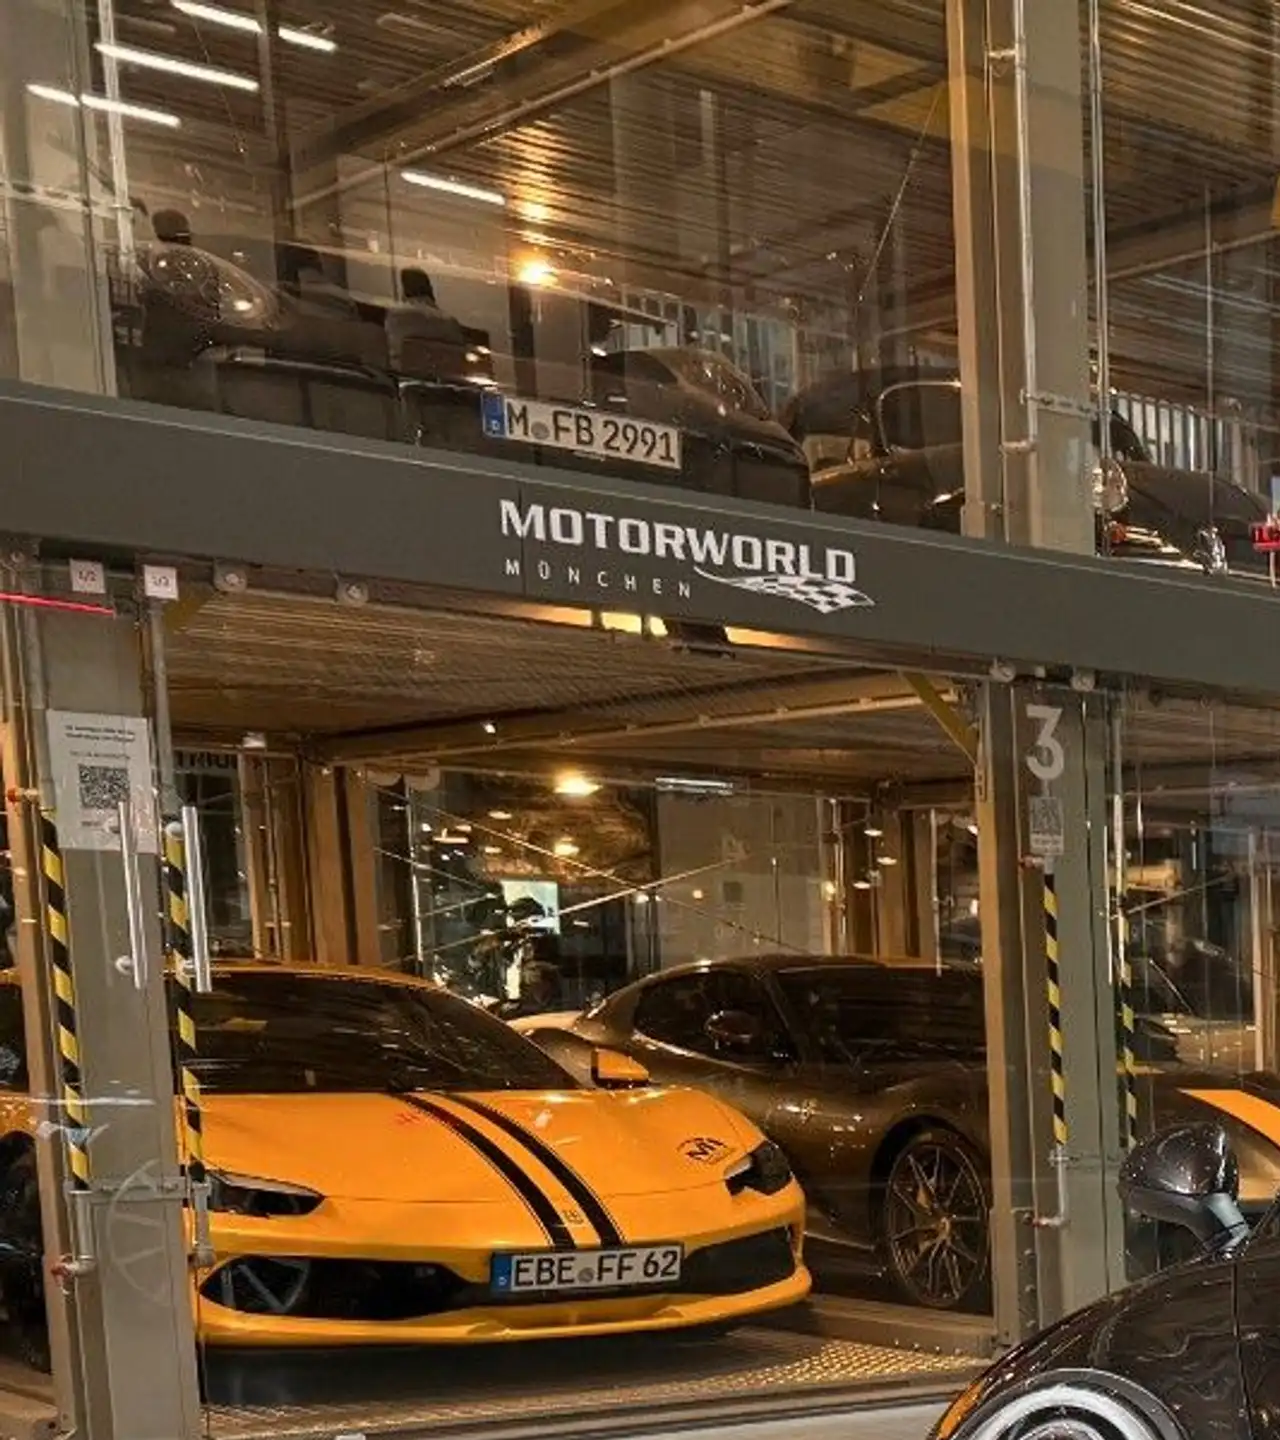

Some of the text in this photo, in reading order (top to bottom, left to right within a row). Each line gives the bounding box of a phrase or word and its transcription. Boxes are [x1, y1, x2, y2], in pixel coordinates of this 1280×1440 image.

[508, 402, 529, 436] M
[552, 410, 594, 446] FB
[602, 420, 676, 463] 2991
[500, 499, 856, 584] MOTORWORLD
[506, 559, 691, 600] MÜNCHEN
[1026, 704, 1064, 780] 3
[514, 1255, 575, 1286] EBE
[597, 1252, 640, 1281] FF
[643, 1249, 678, 1278] 62
